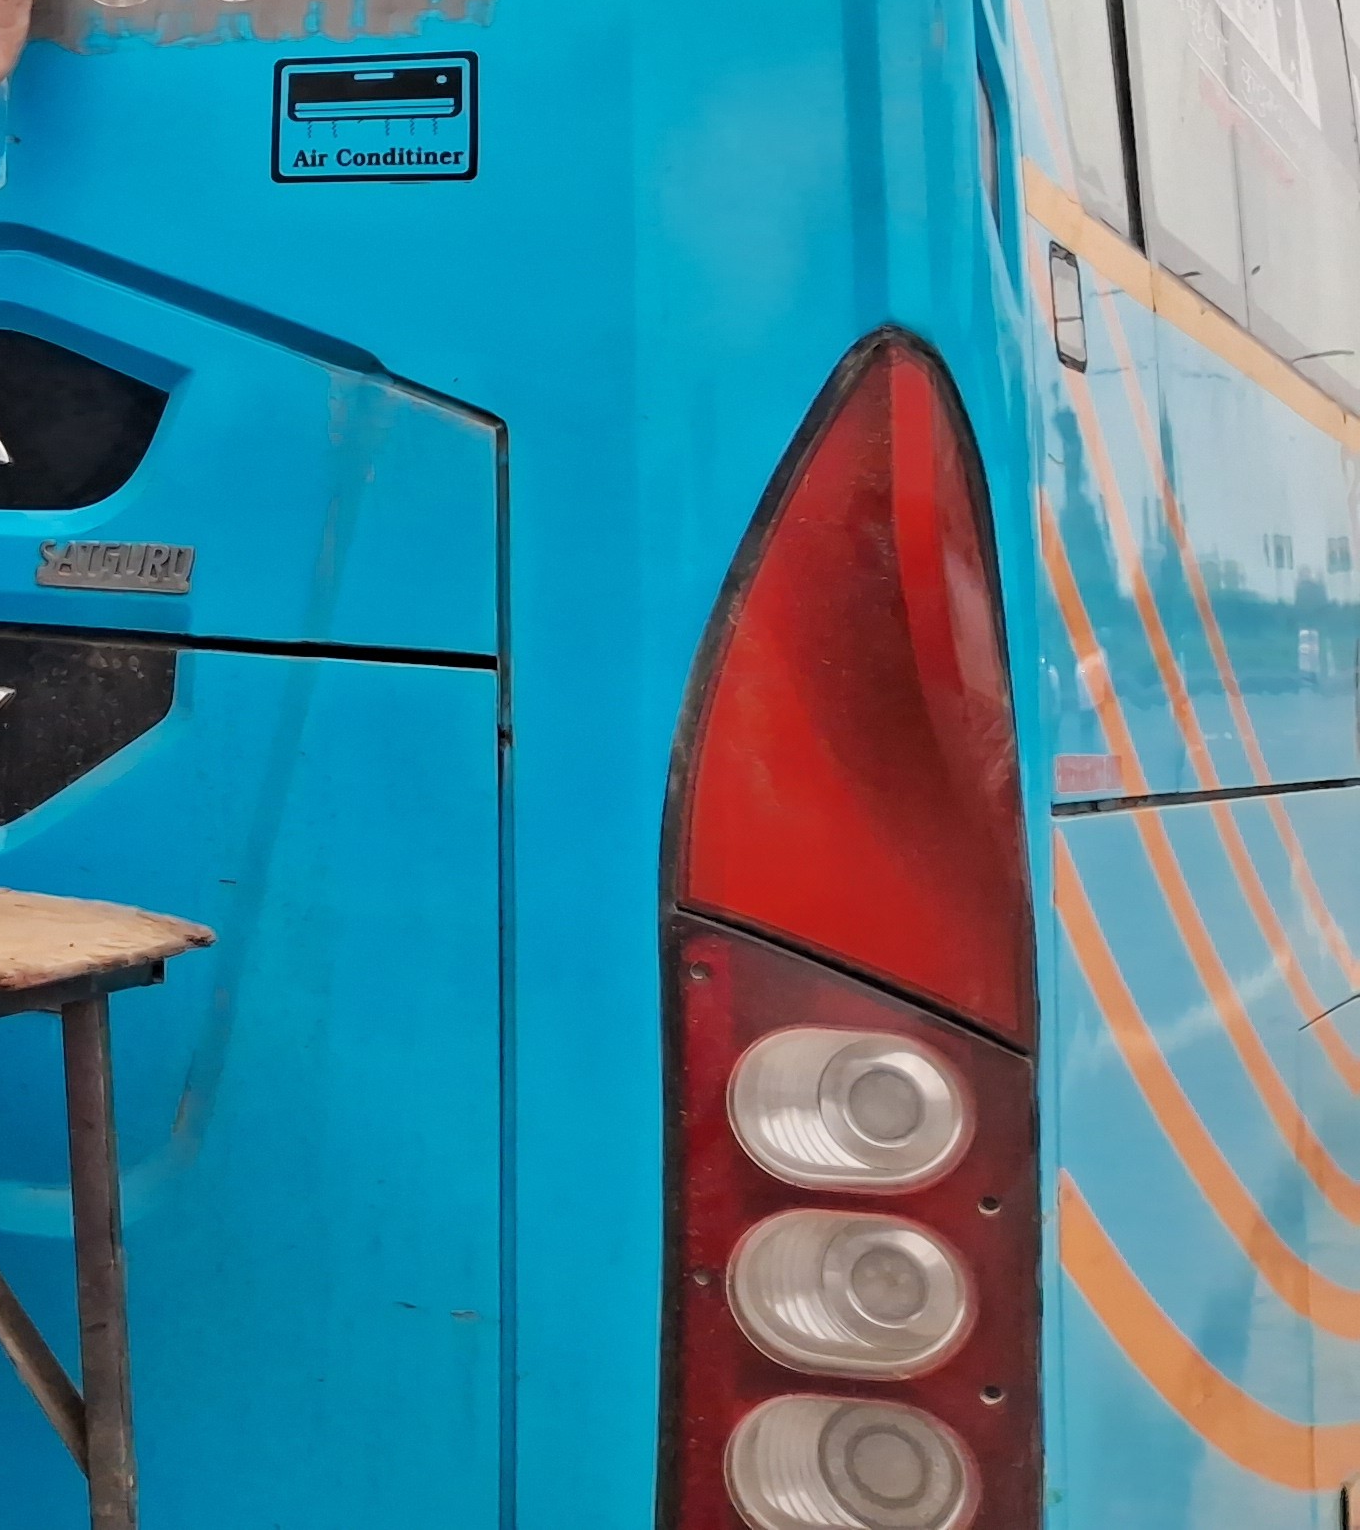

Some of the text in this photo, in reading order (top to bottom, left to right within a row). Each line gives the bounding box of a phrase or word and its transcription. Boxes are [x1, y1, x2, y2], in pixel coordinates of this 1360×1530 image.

[292, 146, 465, 168] Air Conditiner
[37, 539, 196, 584] SATGURU
